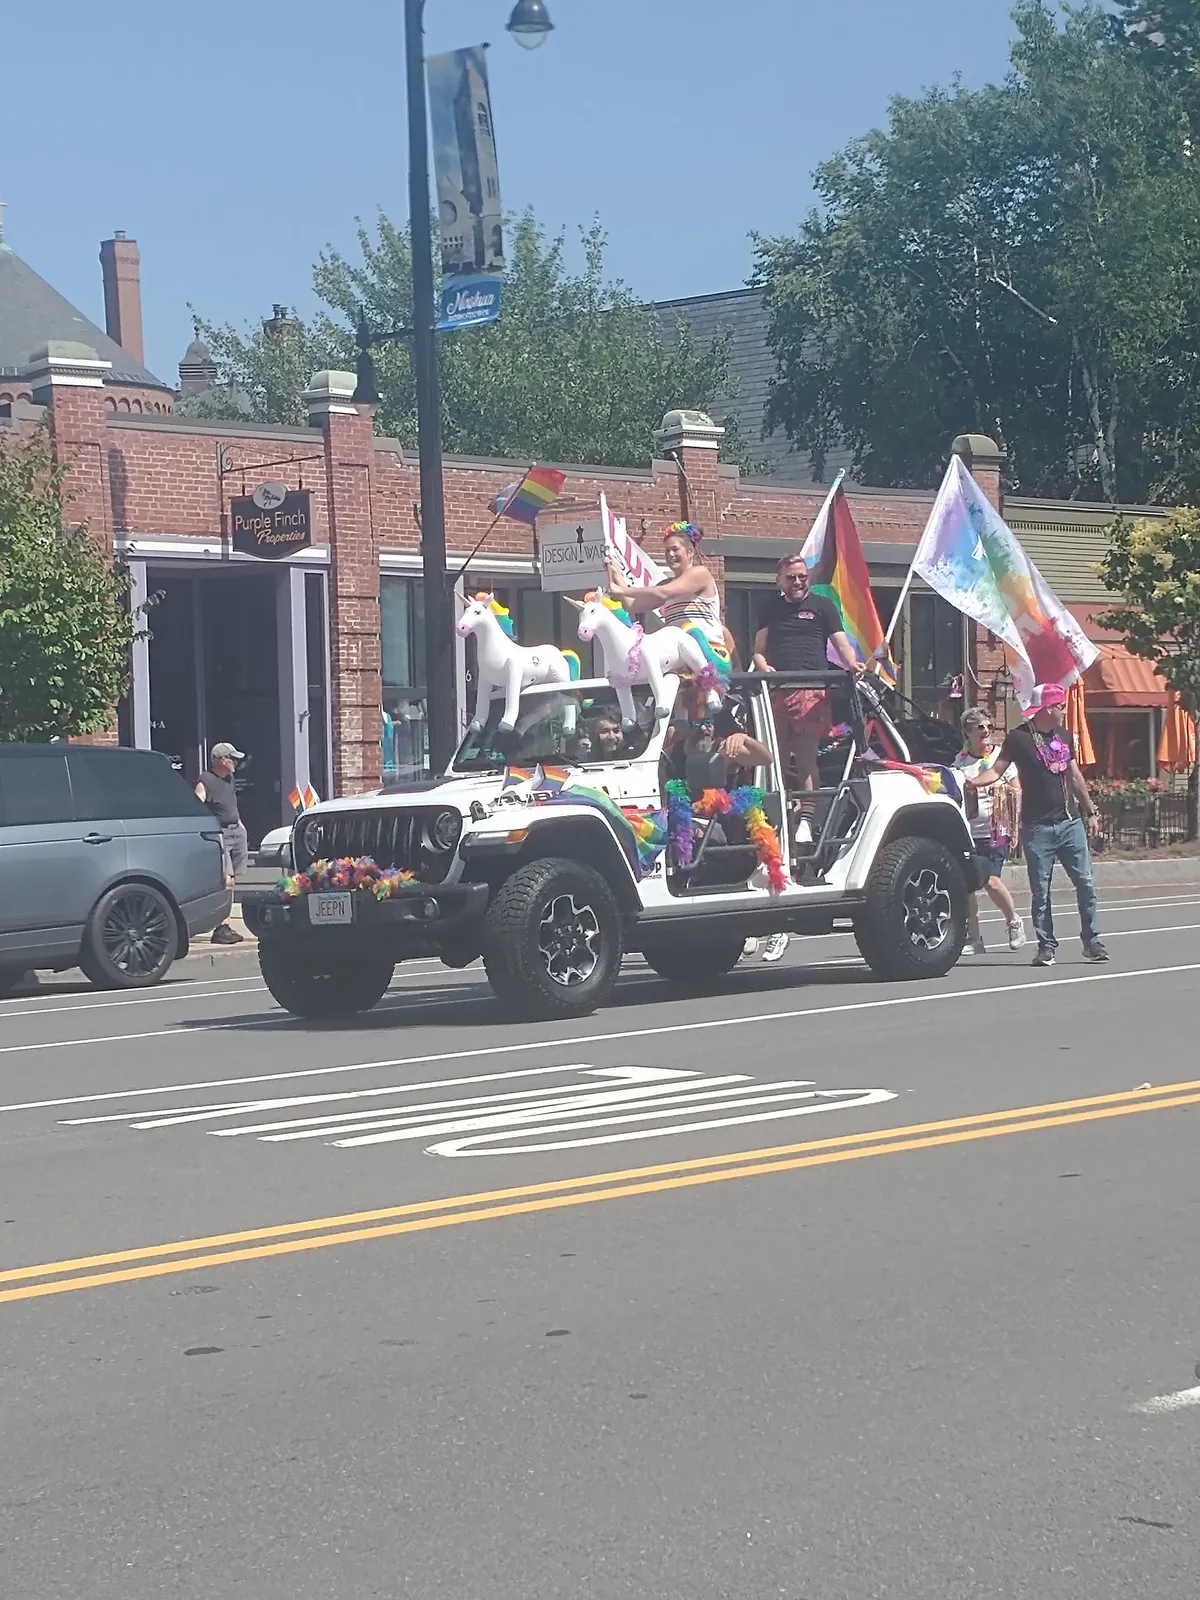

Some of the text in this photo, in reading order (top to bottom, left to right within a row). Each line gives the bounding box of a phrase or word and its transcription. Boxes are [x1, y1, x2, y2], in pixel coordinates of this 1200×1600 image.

[235, 508, 306, 534] Purple Finch
[256, 529, 306, 545] Properties
[544, 544, 607, 564] DESIGN WAR
[465, 669, 472, 682] 6
[315, 900, 345, 917] JEEPN
